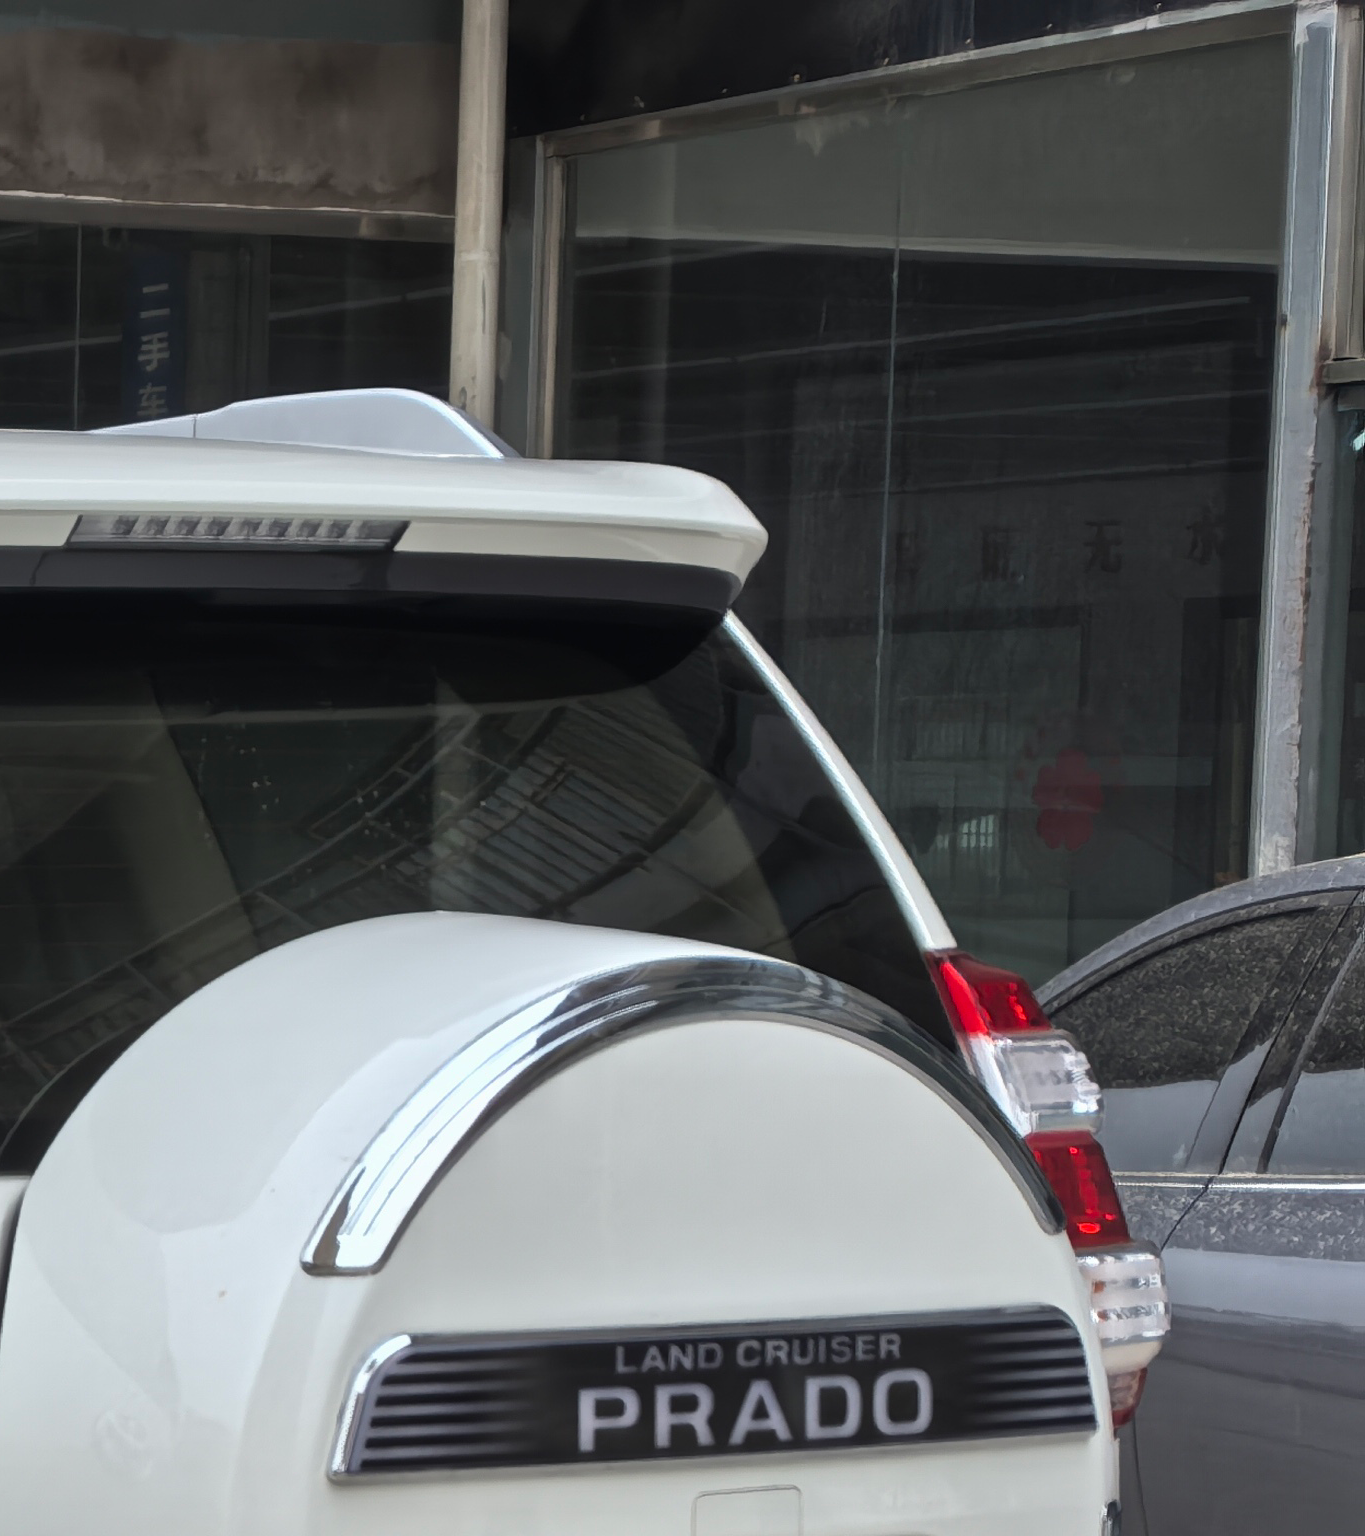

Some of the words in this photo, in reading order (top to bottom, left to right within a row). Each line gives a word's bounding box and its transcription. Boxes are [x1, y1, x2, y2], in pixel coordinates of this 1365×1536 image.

[136, 283, 171, 421] 二手车
[616, 1340, 723, 1374] LAND
[736, 1332, 902, 1368] CRUISER
[577, 1367, 934, 1453] PRADO
